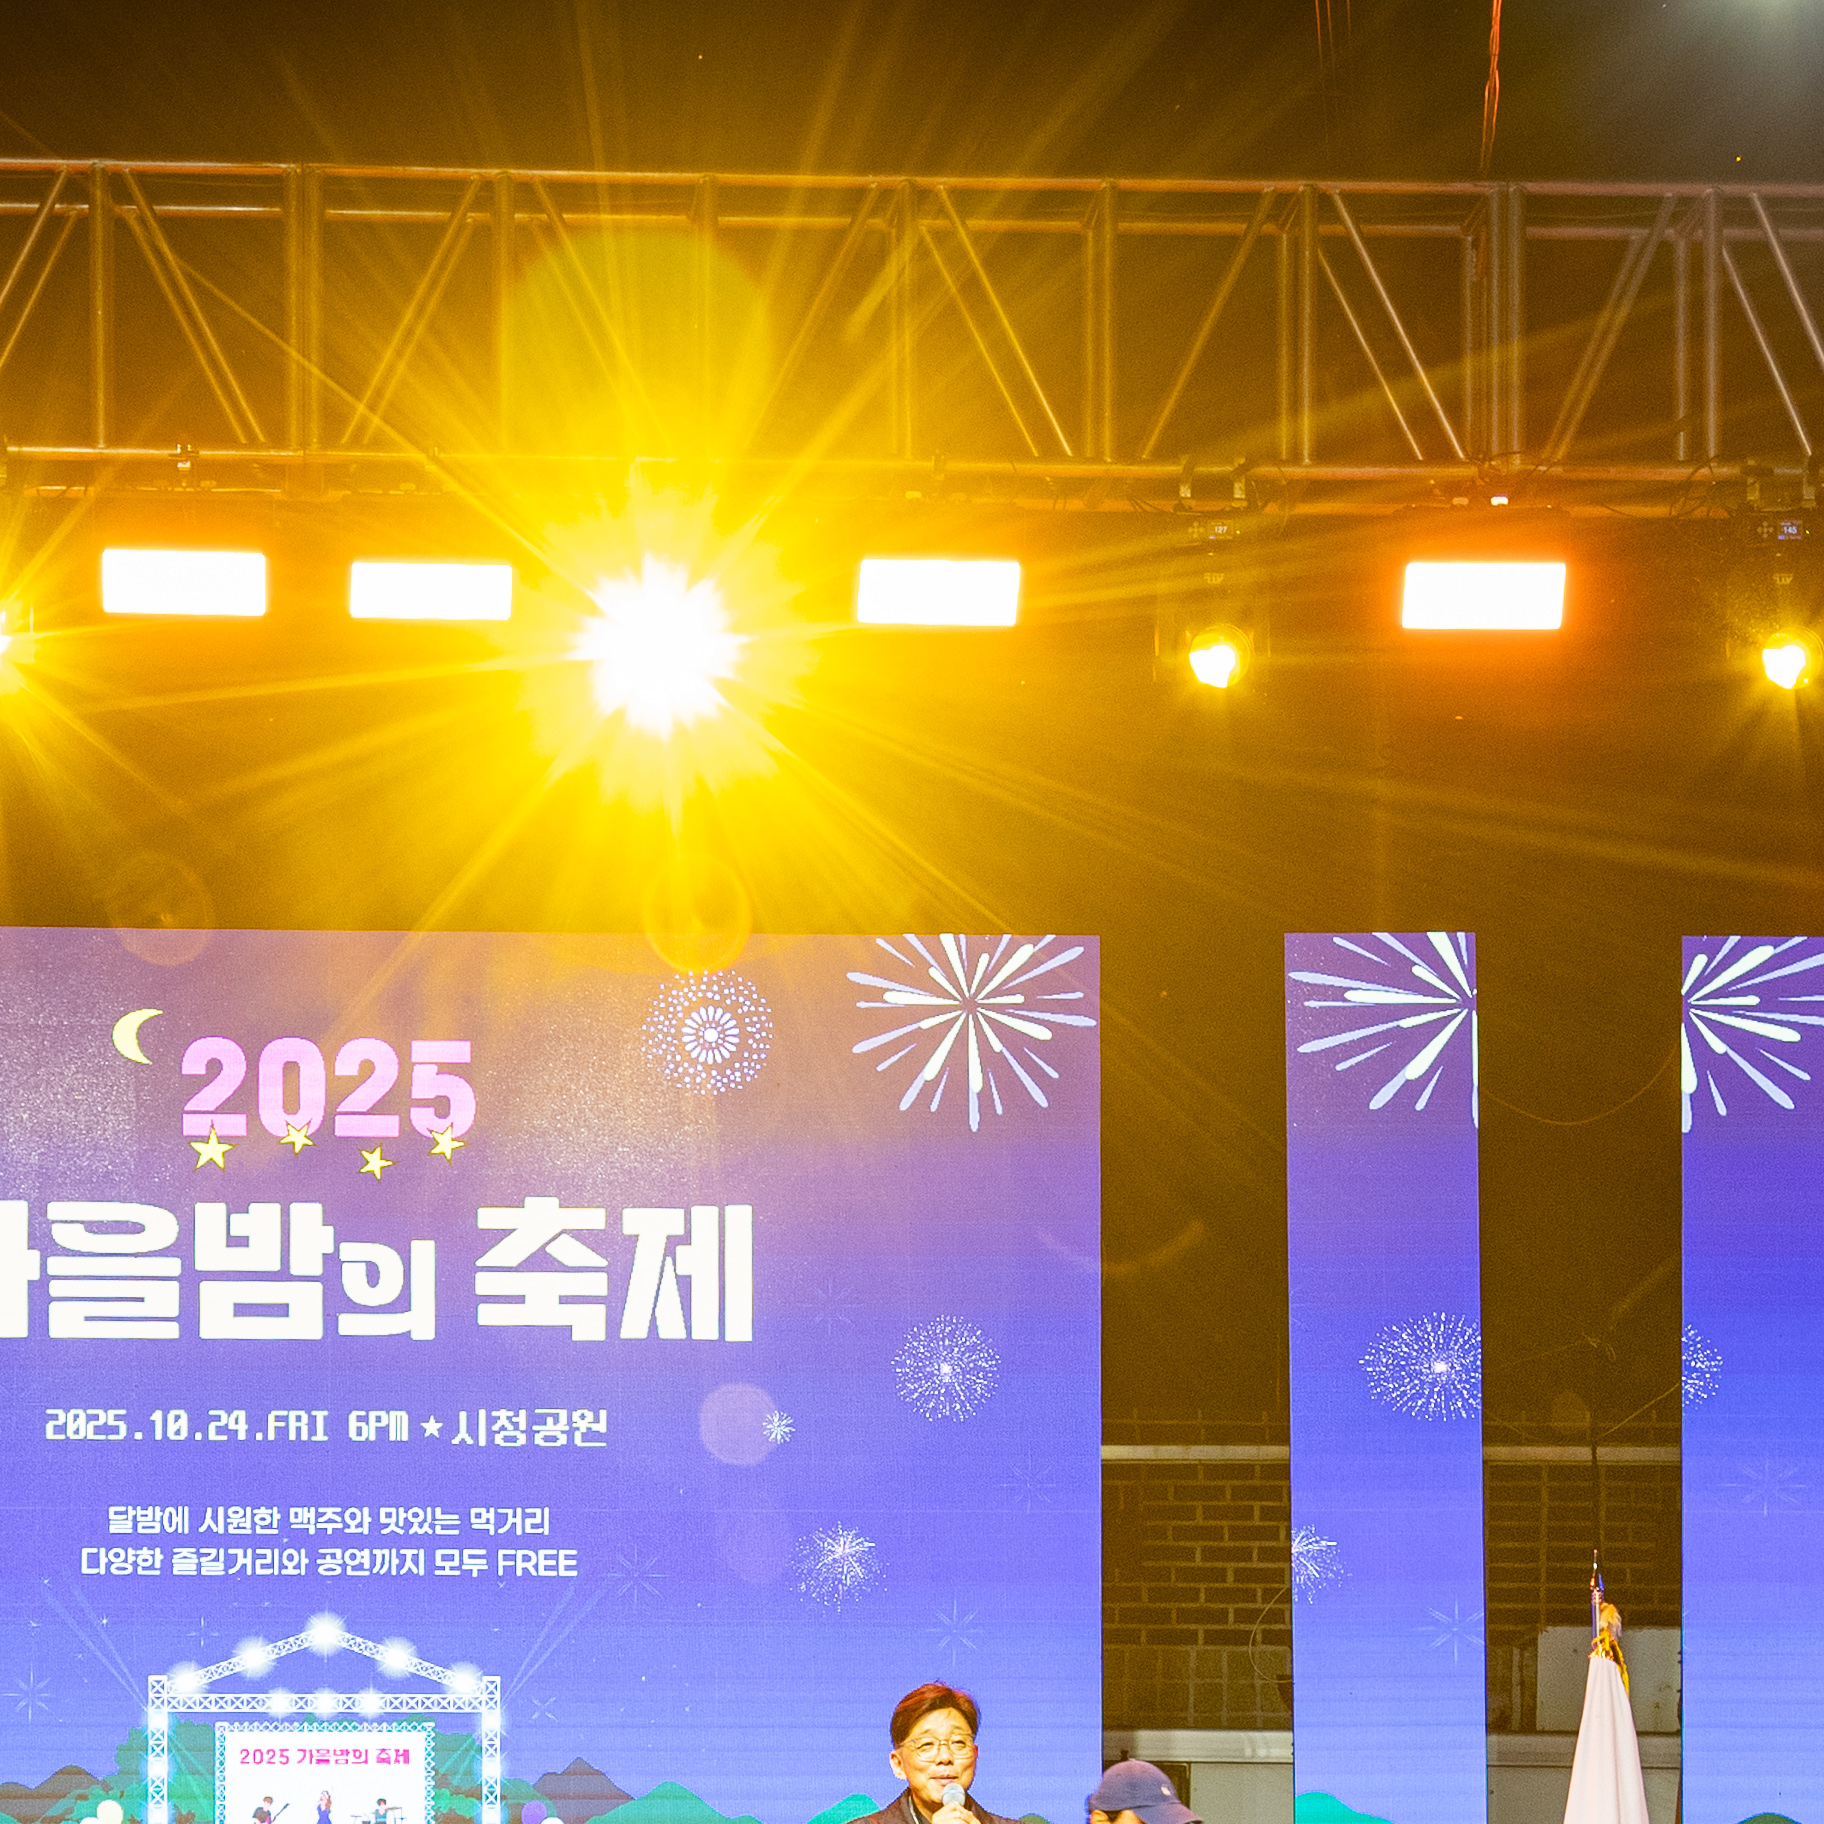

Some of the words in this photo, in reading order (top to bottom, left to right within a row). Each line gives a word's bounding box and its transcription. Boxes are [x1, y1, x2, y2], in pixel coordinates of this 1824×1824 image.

[181, 1036, 476, 1139] 2025
[475, 1197, 754, 1342] 축제
[45, 1409, 329, 1441] 2025.10.24.FRI
[451, 1408, 608, 1448] 시청공원
[107, 1506, 190, 1536] 달밤에
[198, 1506, 280, 1535] 시원한
[289, 1506, 372, 1535] 맥주와
[380, 1506, 462, 1536] 맛있는
[470, 1506, 551, 1536] 먹거리
[81, 1547, 164, 1577] 다양한
[171, 1547, 309, 1577] 즐길거리와
[316, 1547, 425, 1577] 공연까지
[434, 1548, 489, 1577] 모두
[497, 1549, 579, 1577] FREE
[240, 1748, 290, 1765] 2025
[296, 1748, 369, 1765] 가을밤의
[375, 1748, 410, 1765] 축제
